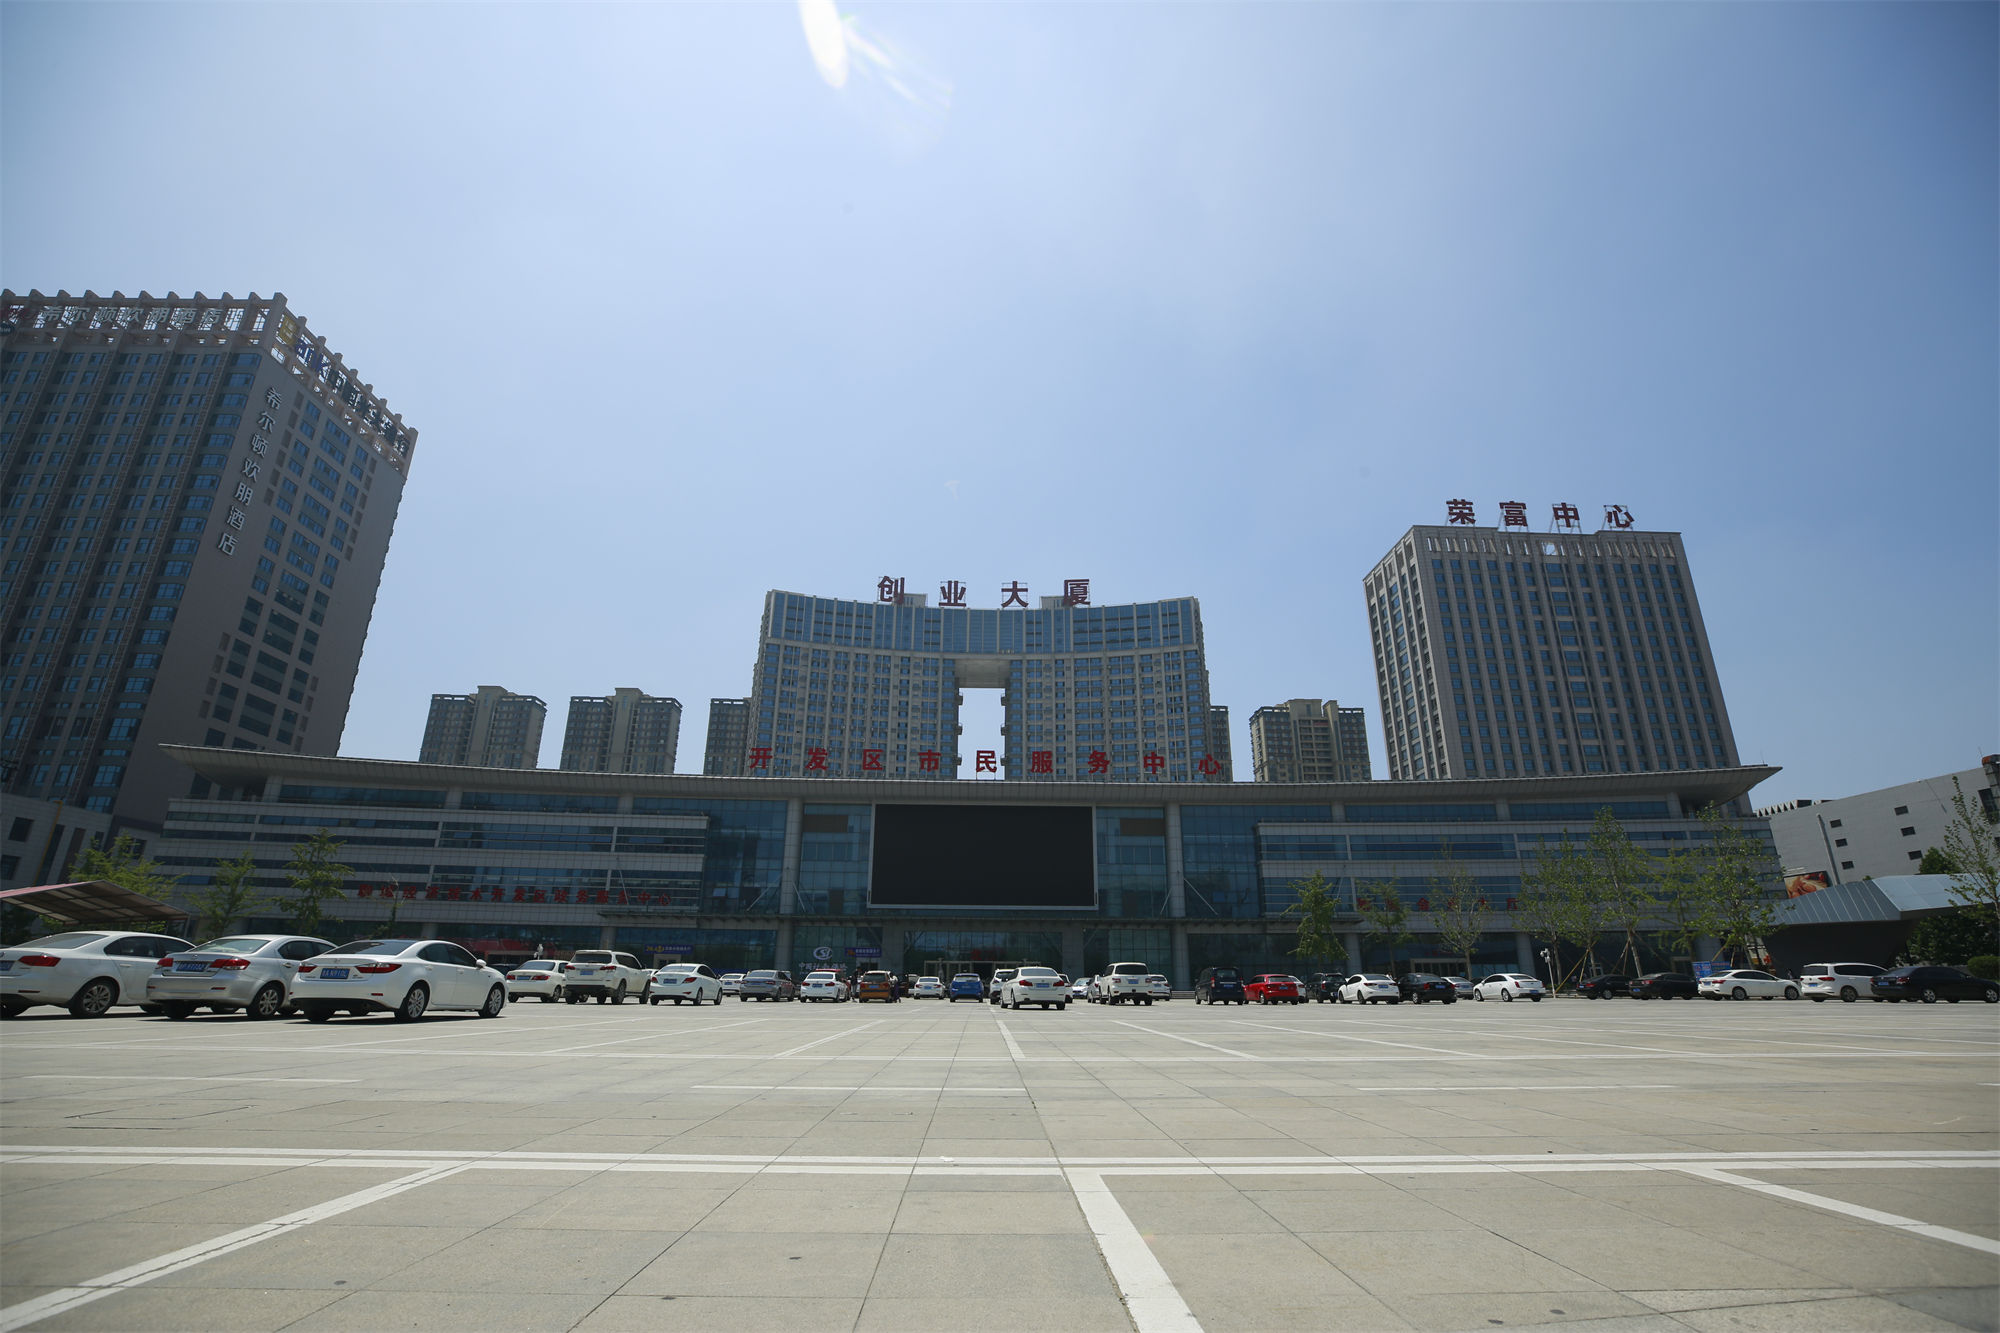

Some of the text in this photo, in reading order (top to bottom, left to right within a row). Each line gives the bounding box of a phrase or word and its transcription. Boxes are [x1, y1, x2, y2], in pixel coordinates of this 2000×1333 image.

[41, 305, 224, 324] 希尔顿欢朋酒店
[217, 387, 282, 556] 希尔顿欢朋酒店
[1446, 499, 1635, 529] 荣富中心
[877, 575, 1091, 608] 创业大厦
[749, 747, 1222, 775] 开发区市民服务中心
